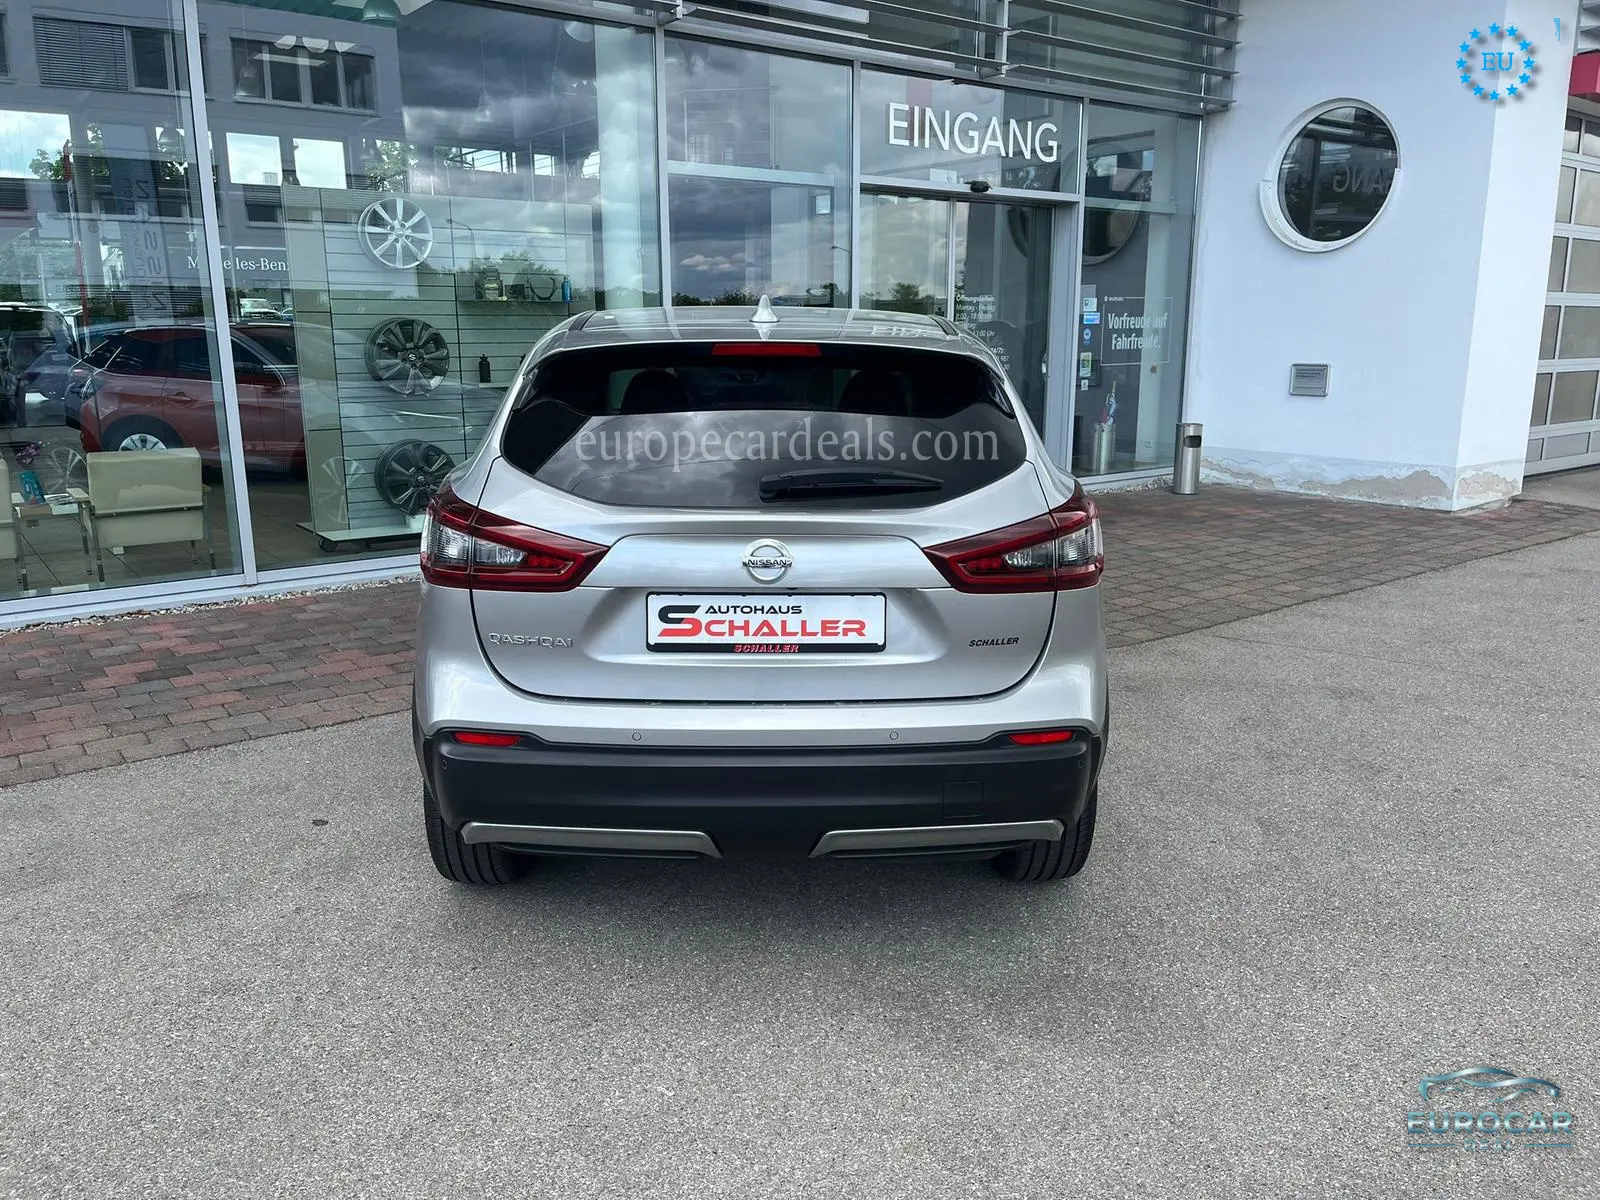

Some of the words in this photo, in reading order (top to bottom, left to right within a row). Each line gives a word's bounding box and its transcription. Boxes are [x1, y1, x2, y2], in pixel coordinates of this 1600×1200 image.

[889, 102, 1058, 163] EINGANG
[747, 558, 787, 567] NISSAN
[704, 605, 803, 615] AUTOHAUS
[658, 605, 867, 637] SCHALLER
[488, 632, 573, 648] QASHQAI
[969, 637, 1019, 647] SCHALLER
[734, 643, 799, 653] SCHALLER
